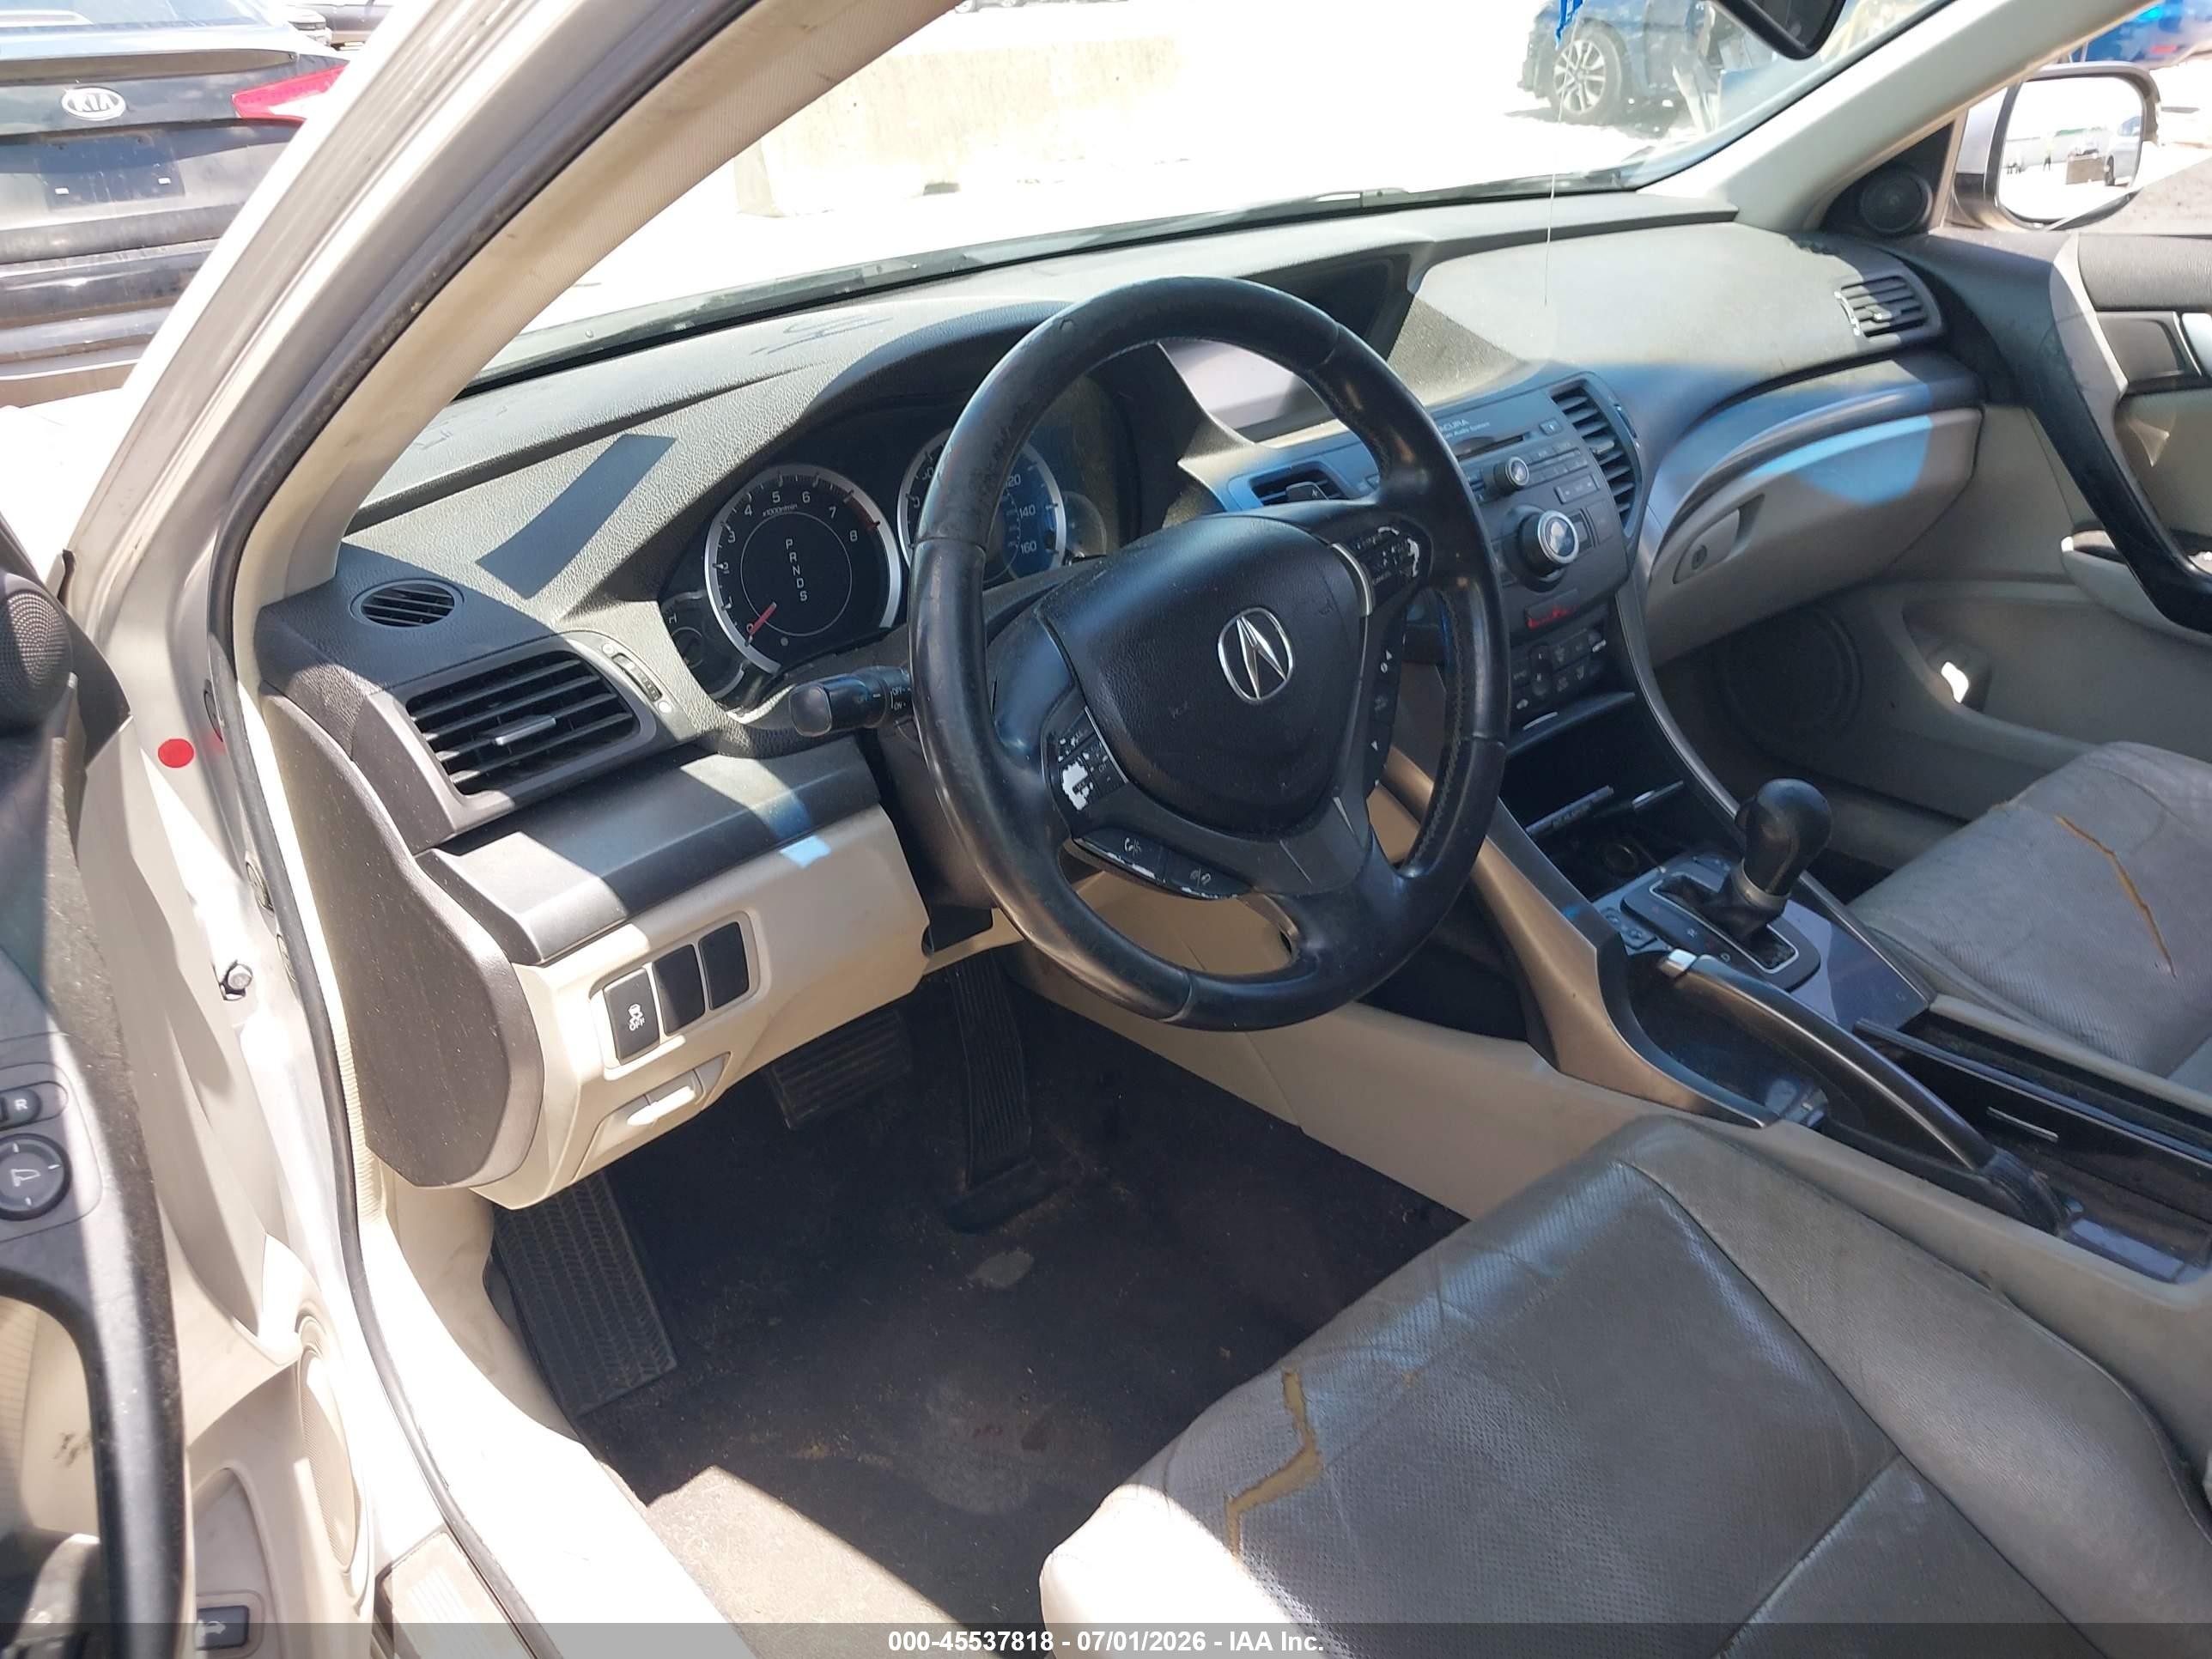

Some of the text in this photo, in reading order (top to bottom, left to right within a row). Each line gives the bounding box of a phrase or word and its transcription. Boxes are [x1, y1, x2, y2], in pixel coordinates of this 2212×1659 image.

[70, 92, 119, 112] KIA
[773, 490, 781, 503] 5
[802, 491, 811, 503] 6
[744, 504, 753, 517] 4
[829, 506, 837, 519] 7
[1019, 504, 1036, 518] 140
[727, 531, 736, 543] 3
[849, 530, 858, 542] 8
[785, 538, 793, 550] P
[1020, 540, 1037, 555] 160
[789, 551, 798, 563] R
[792, 564, 801, 576] N
[796, 577, 805, 589] D
[799, 589, 808, 601] S
[629, 1017, 645, 1031] OFF
[15, 1098, 28, 1111] R
